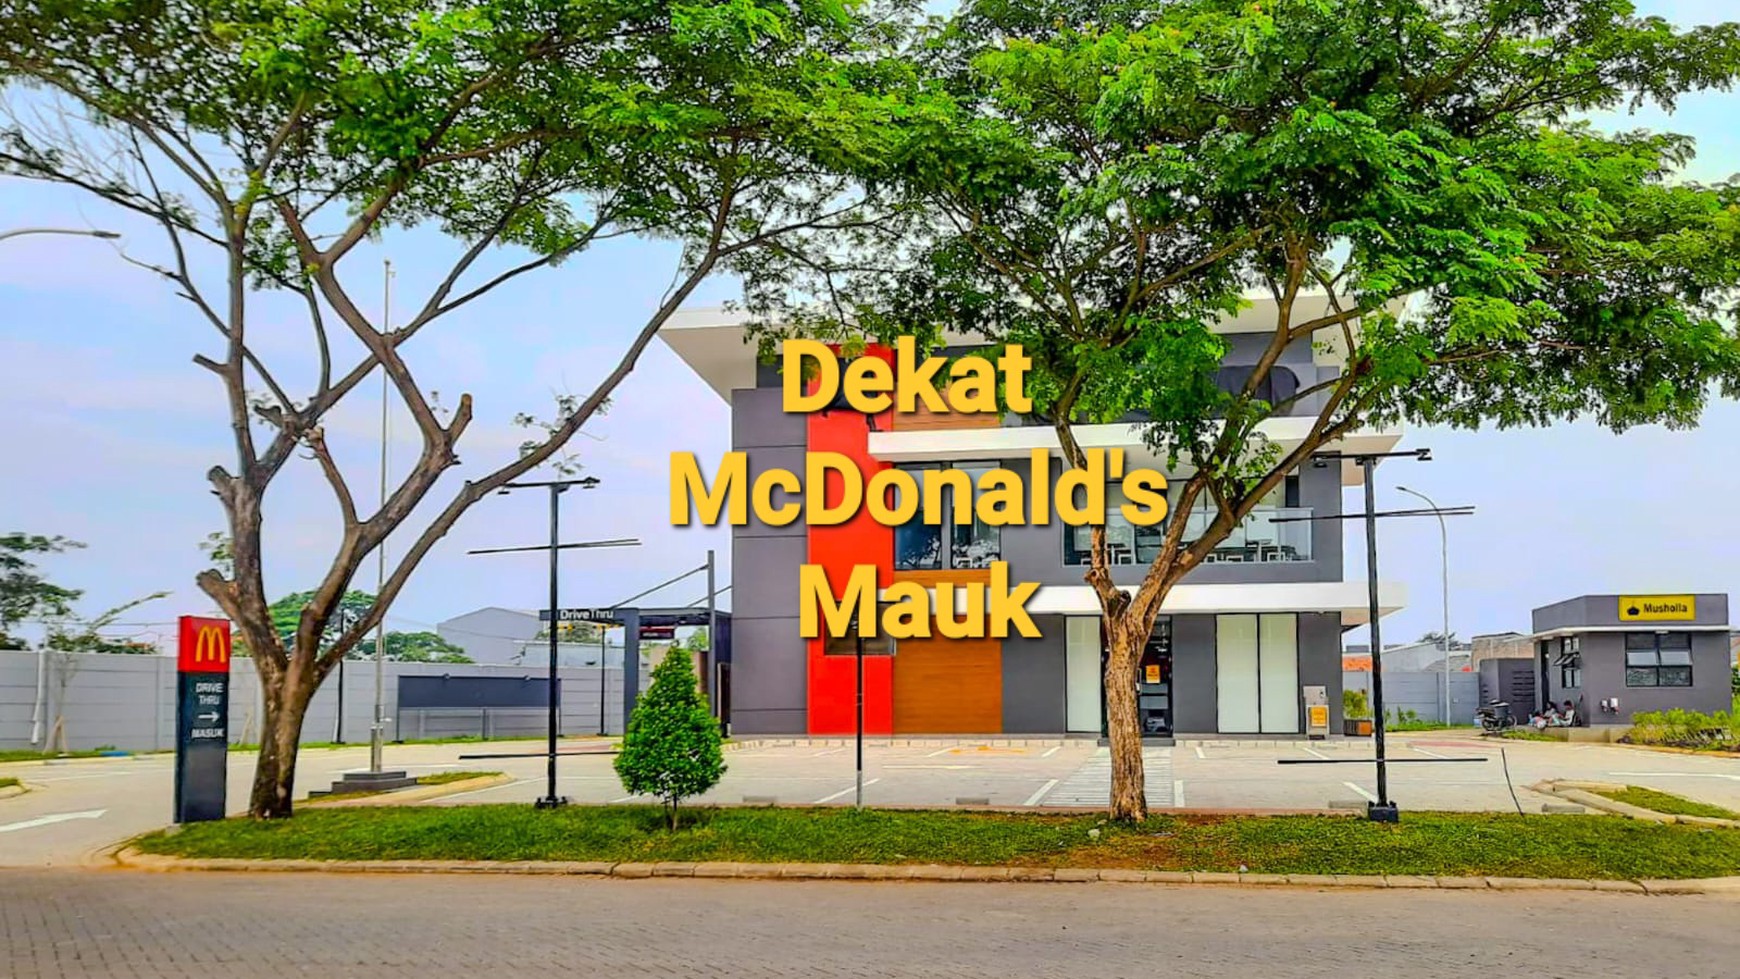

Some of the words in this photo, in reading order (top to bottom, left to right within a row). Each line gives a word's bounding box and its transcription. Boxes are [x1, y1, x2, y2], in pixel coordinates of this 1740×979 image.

[1643, 602, 1688, 613] Musholla
[195, 682, 224, 693] DRIVE
[198, 694, 220, 705] THRU
[191, 728, 225, 738] MASUK
